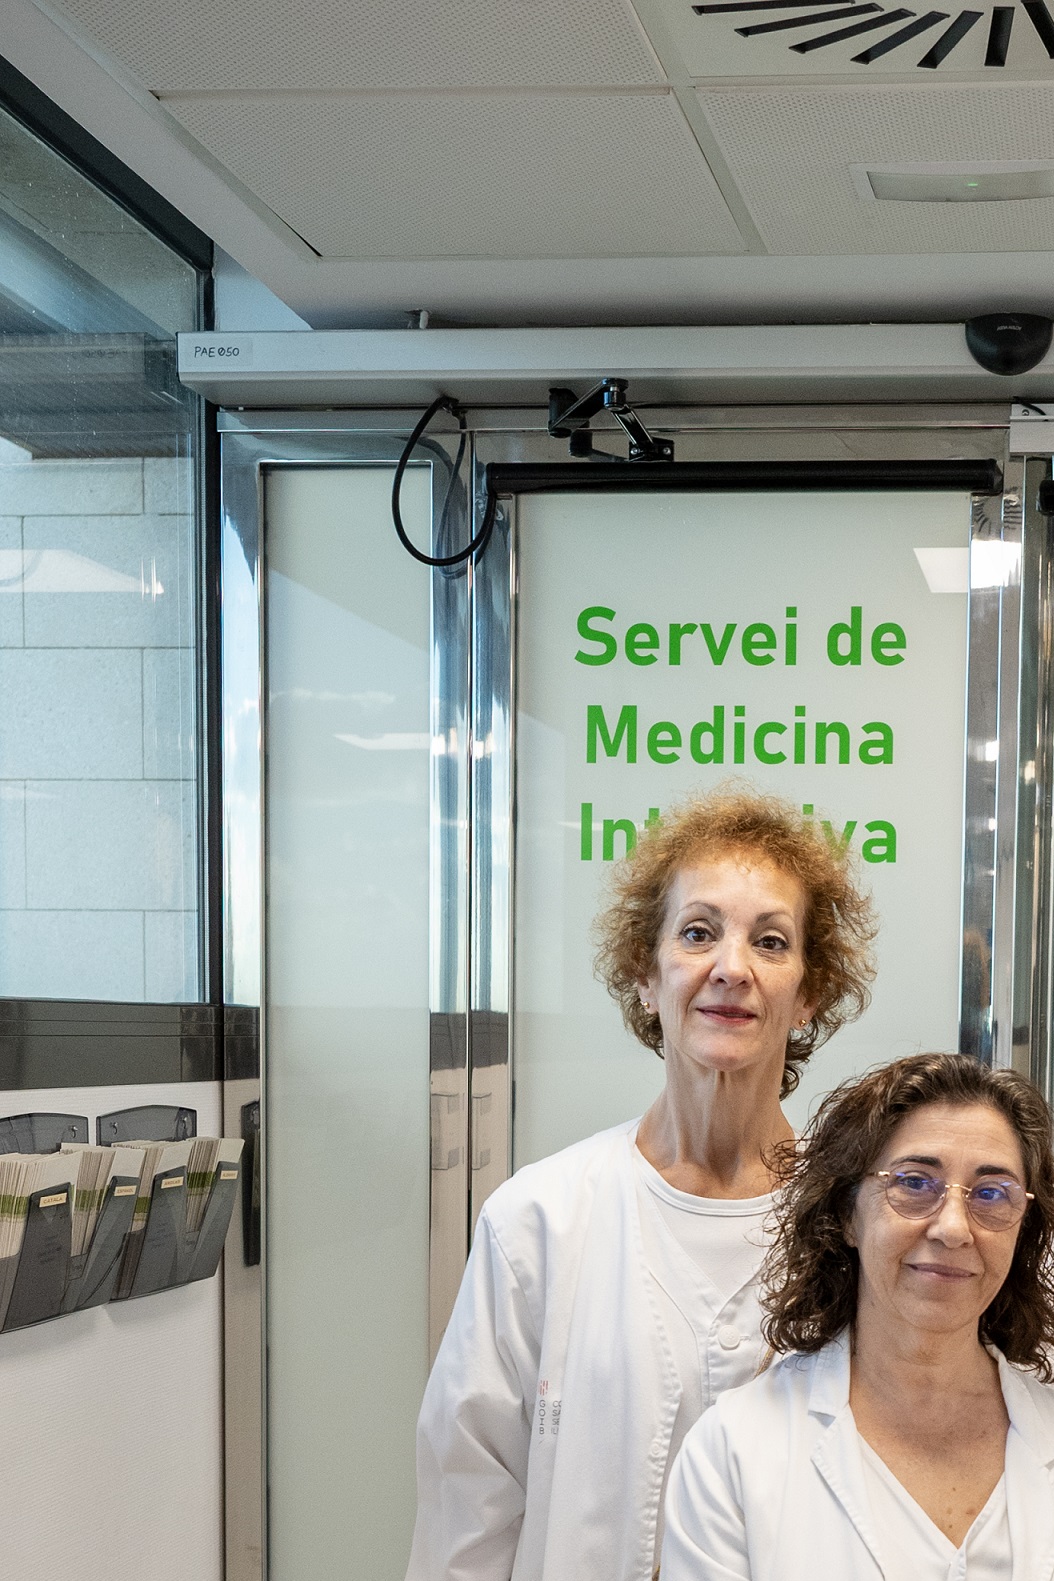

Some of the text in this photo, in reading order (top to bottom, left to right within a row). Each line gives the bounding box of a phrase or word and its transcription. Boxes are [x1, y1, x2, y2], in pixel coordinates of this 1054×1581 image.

[574, 606, 907, 666] Servei de
[586, 705, 893, 764] Medicina
